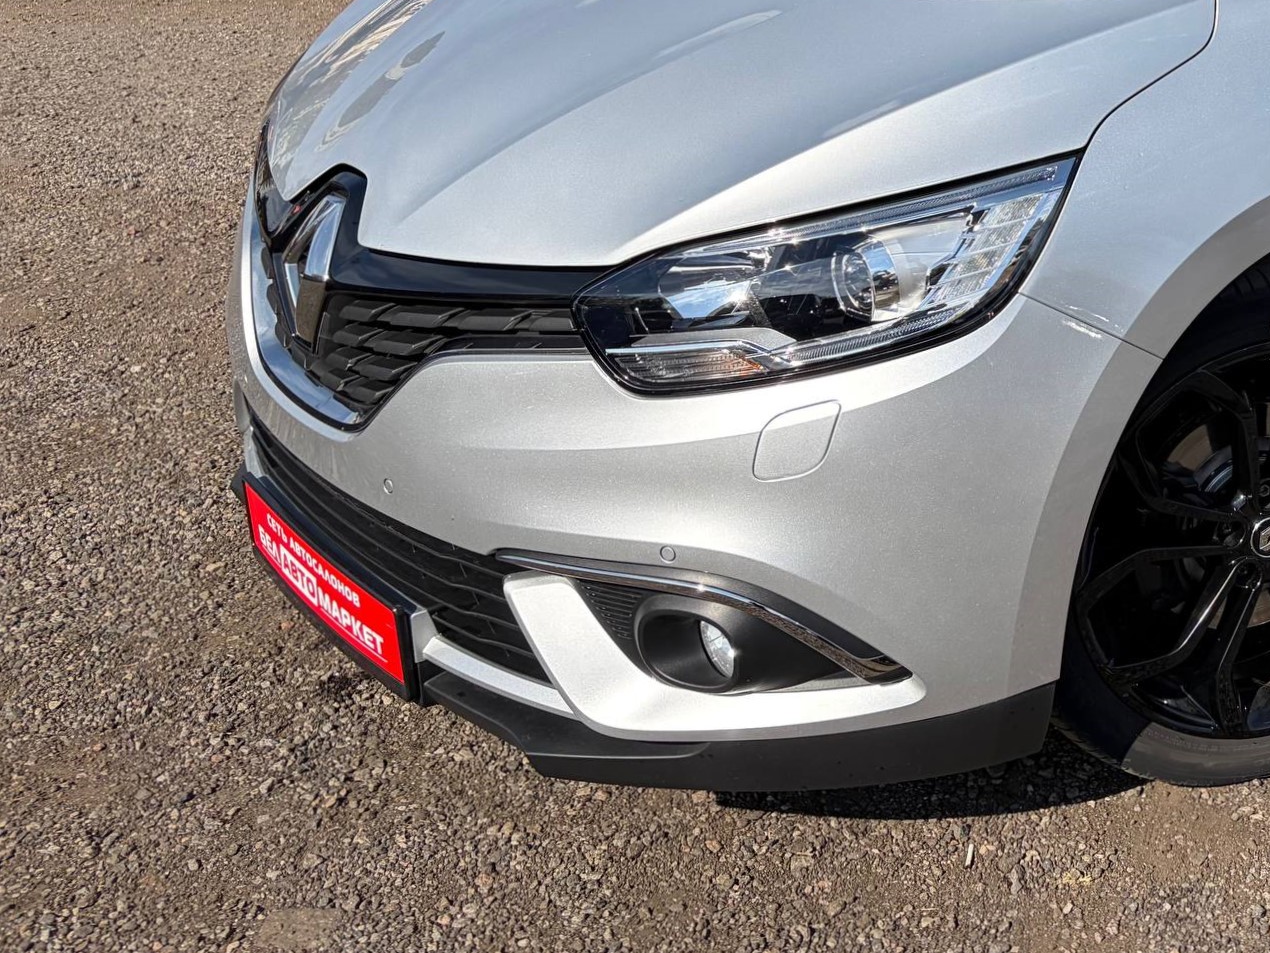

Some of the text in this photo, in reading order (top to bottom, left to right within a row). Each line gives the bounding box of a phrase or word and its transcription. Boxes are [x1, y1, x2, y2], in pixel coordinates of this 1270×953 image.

[257, 526, 384, 655] БЕЛ АВТО МАРКЕТ
[266, 513, 361, 608] СЕТЬ АВТОСАЛОНОВ
